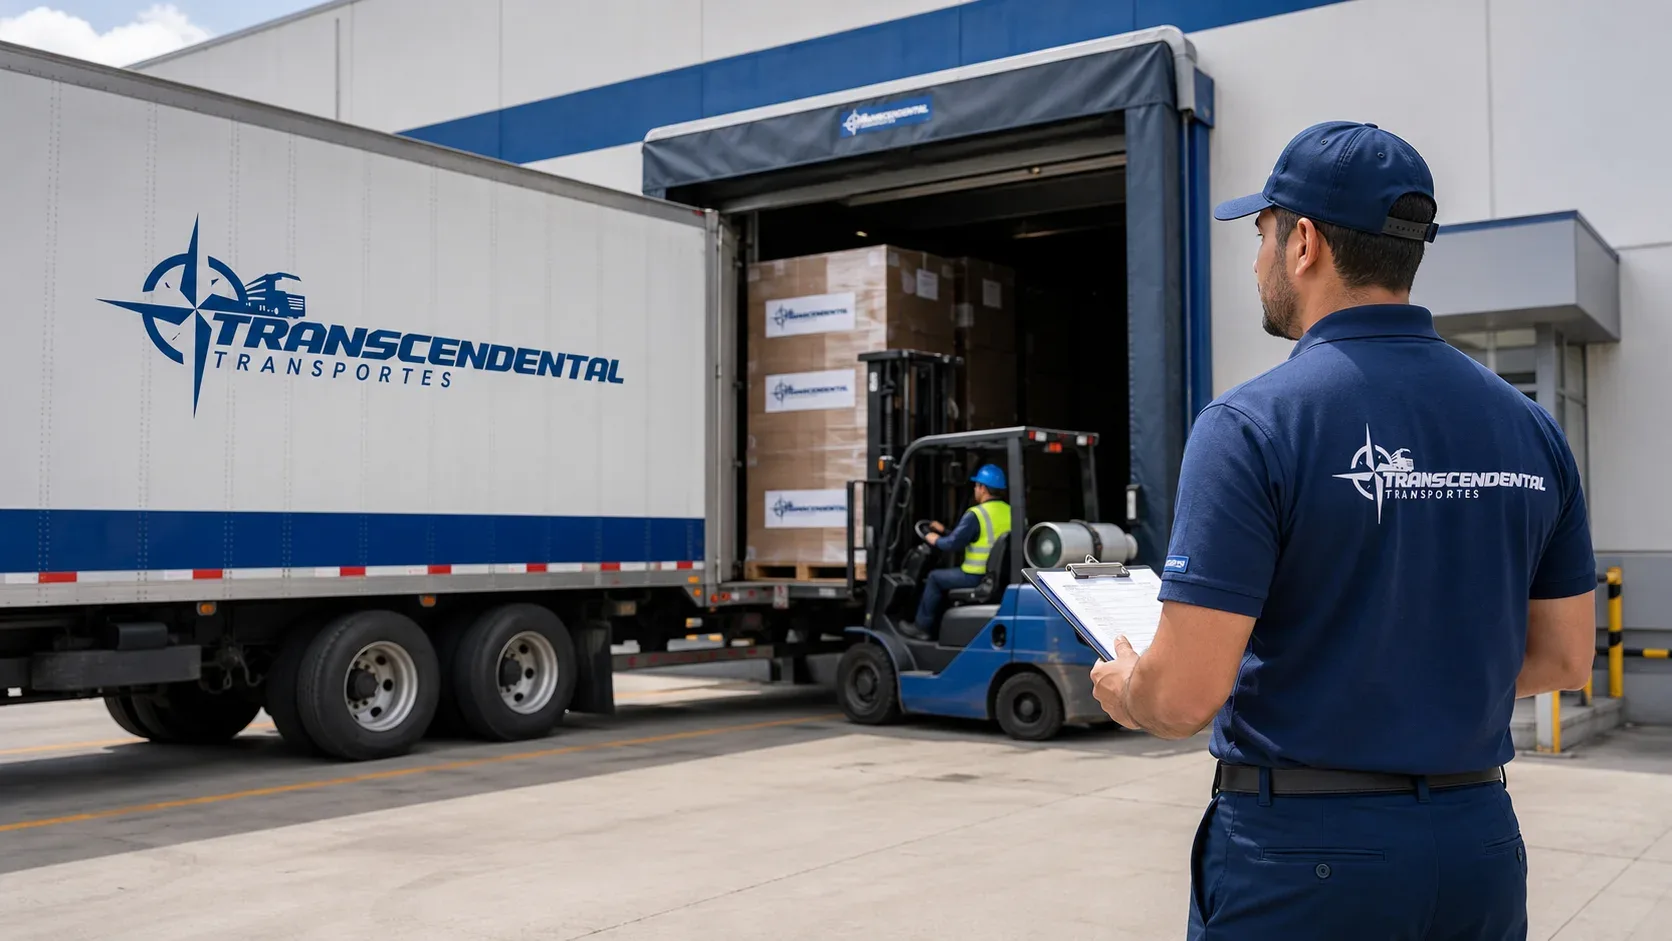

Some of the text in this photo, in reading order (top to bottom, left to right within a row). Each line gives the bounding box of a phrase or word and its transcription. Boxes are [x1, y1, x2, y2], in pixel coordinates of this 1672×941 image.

[211, 312, 624, 385] TRANSCENDENTAL
[215, 351, 452, 388] TRANSPORTES
[1383, 471, 1546, 491] TRANSCENDENTAL
[1385, 489, 1480, 499] TRANSPORTES
